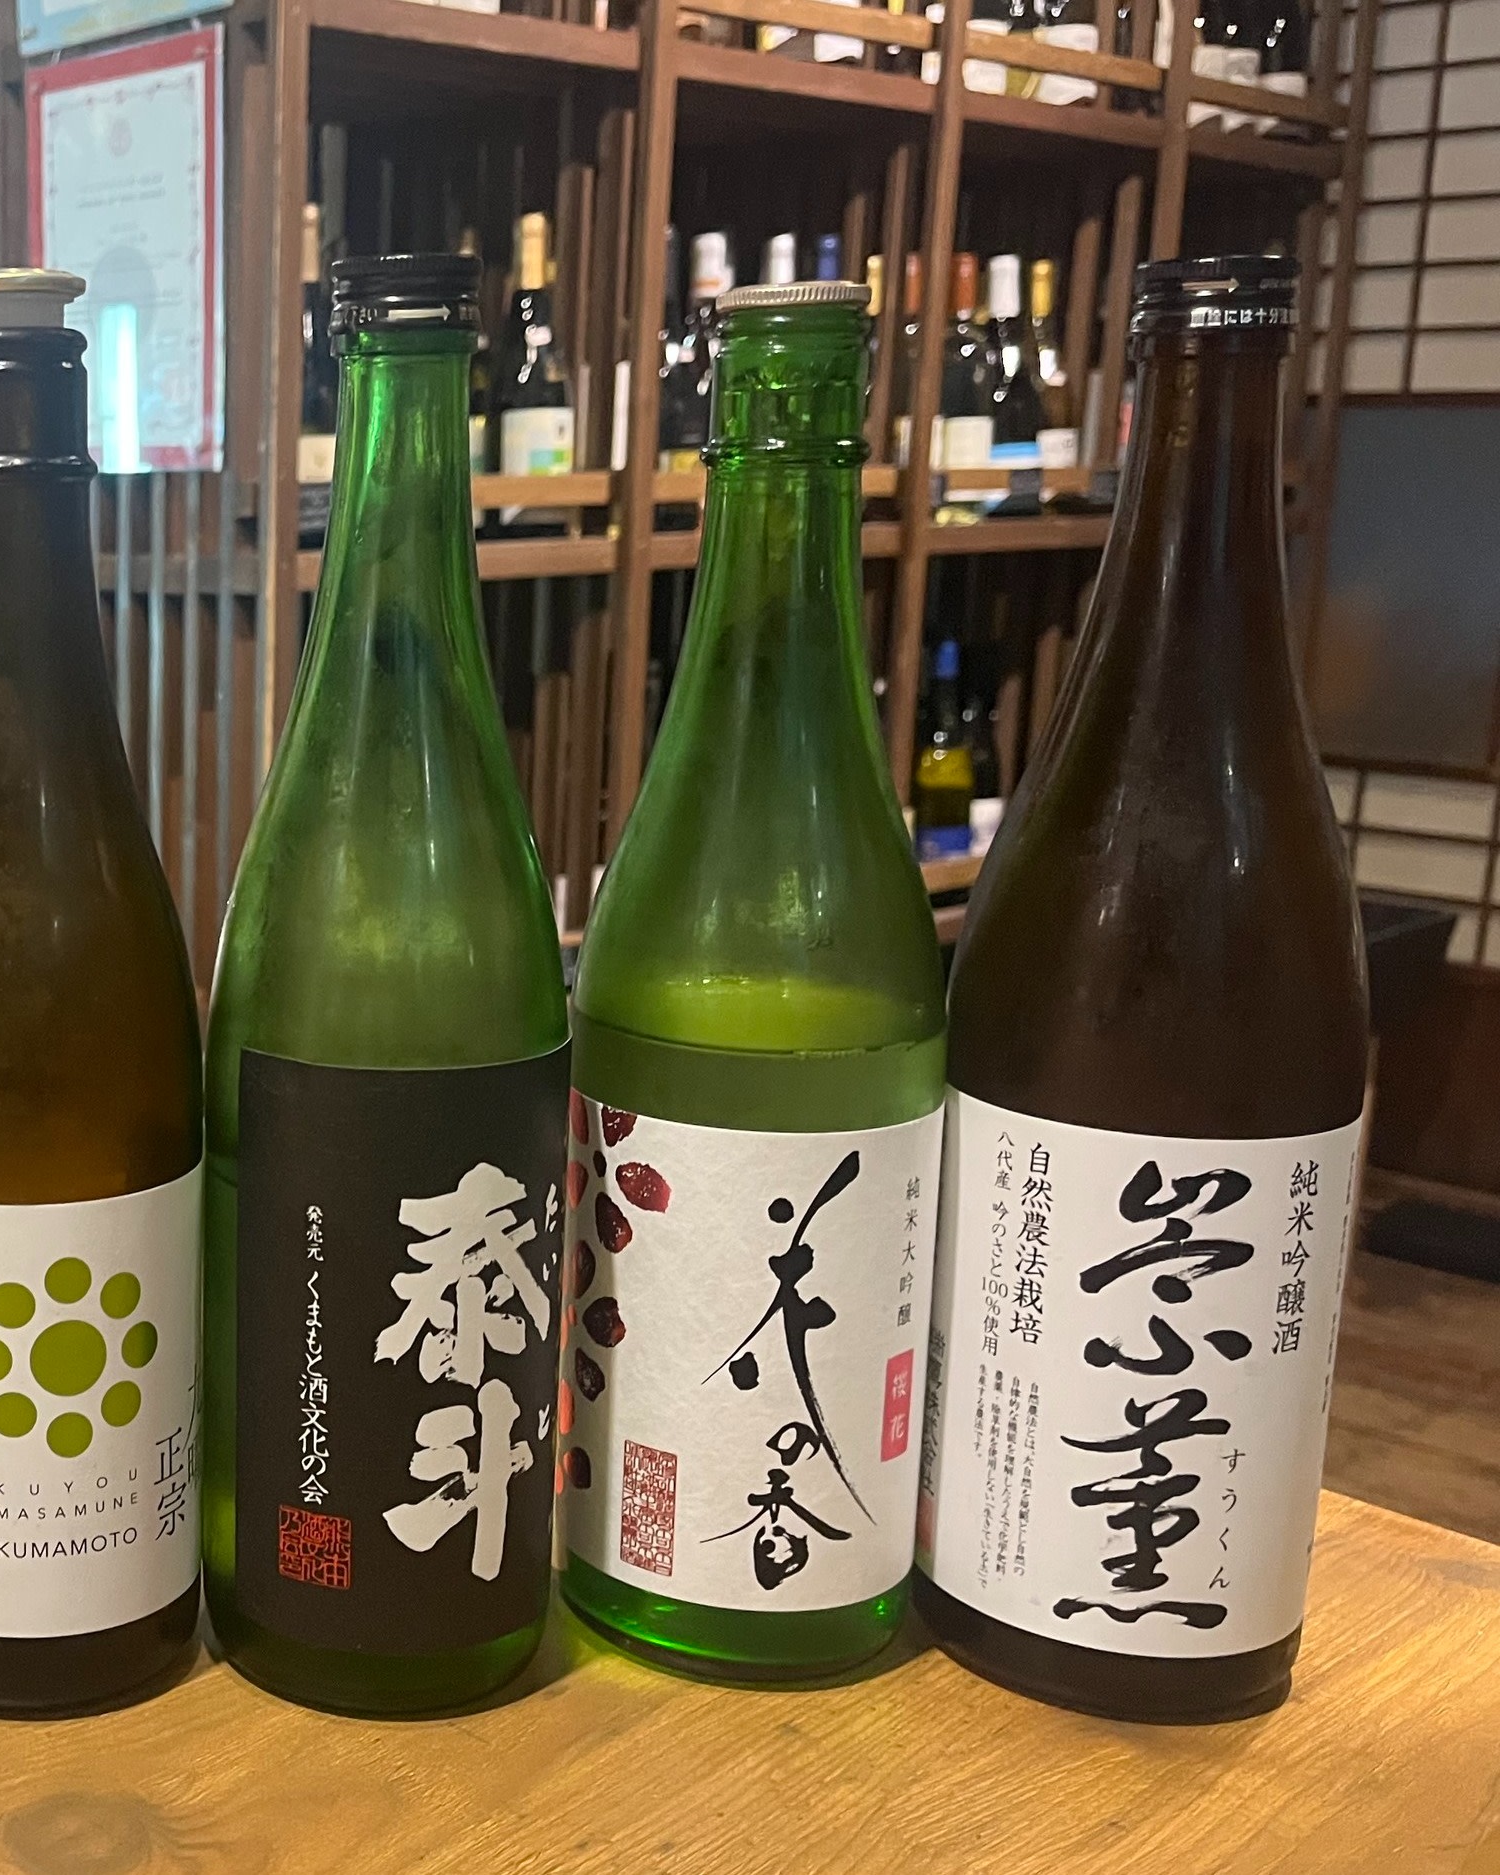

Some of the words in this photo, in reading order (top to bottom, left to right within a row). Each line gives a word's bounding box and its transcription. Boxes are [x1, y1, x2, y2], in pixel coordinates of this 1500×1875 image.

[306, 1205, 324, 1262] 発売元
[995, 1131, 1015, 1191] 八代産
[897, 1177, 920, 1327] 純米大吟醸
[1010, 1142, 1053, 1345] 自然農法栽培
[1271, 1160, 1320, 1356] 純米吟醸酒
[299, 1270, 330, 1505] くまもと酒文化の会
[373, 1162, 551, 1581] 泰斗
[153, 1426, 187, 1541] 正宗
[1208, 1448, 1248, 1591] すうくん
